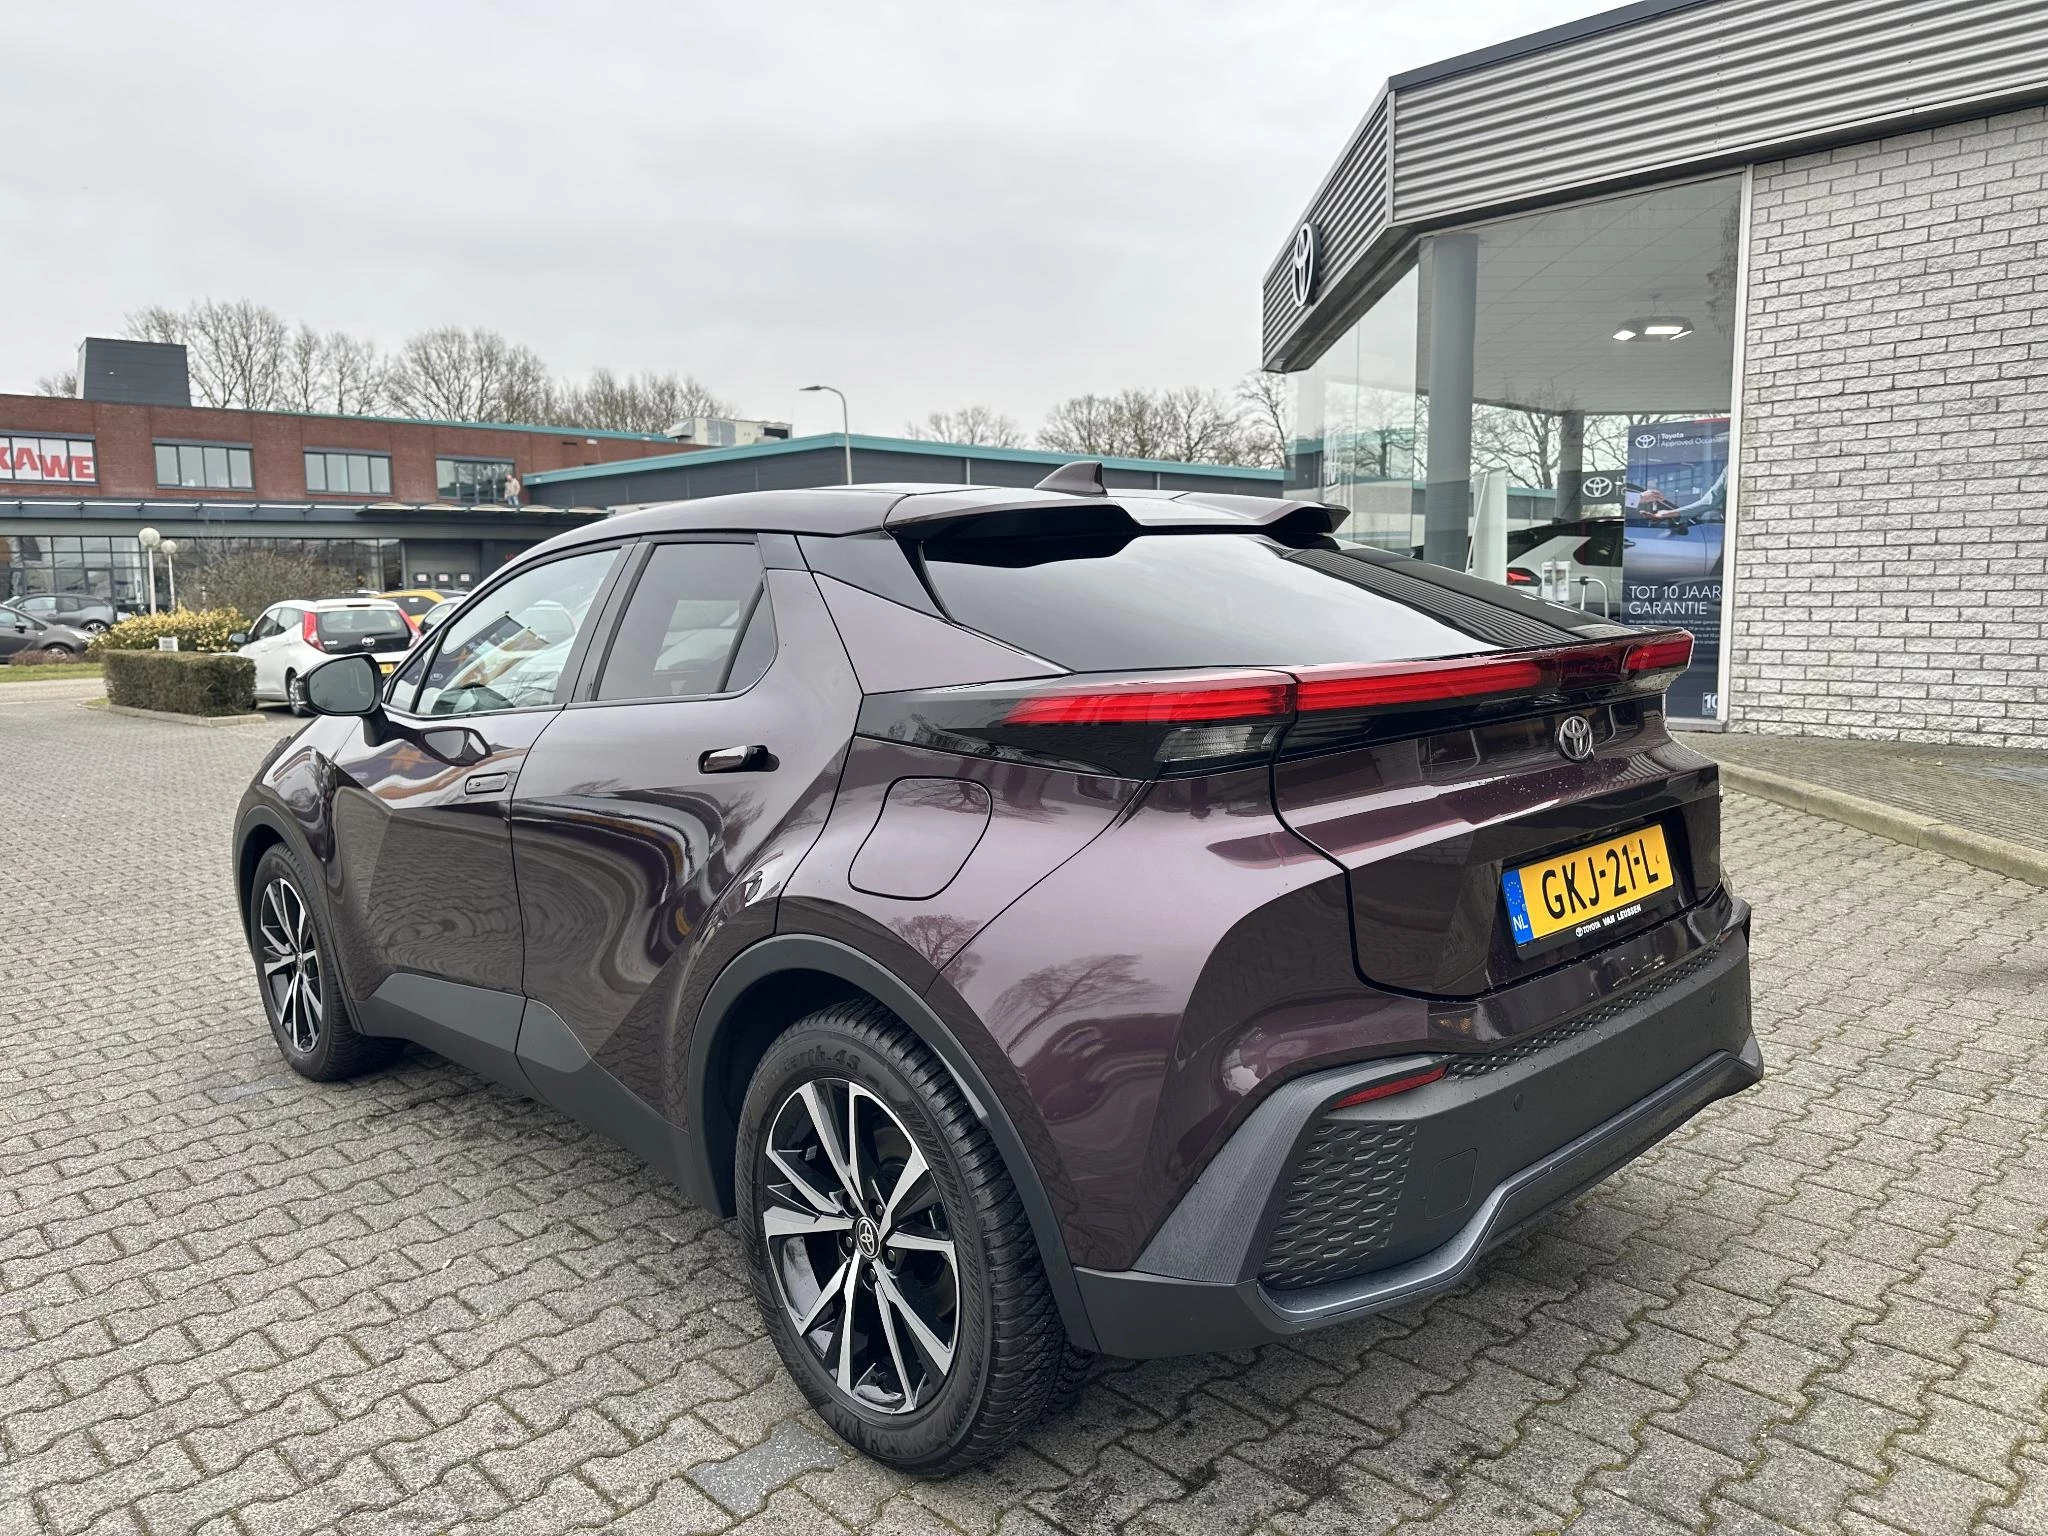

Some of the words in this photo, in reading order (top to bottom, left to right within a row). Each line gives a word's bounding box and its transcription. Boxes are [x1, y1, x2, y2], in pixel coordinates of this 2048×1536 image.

[1661, 432, 1684, 441] Toyota
[1661, 439, 1693, 447] Approved
[1629, 586, 1658, 599] TOT
[1662, 586, 1678, 599] 10
[1682, 585, 1721, 599] JAAR
[1628, 601, 1708, 615] GARANTIE
[1541, 839, 1659, 919] GKJ-21-L
[1512, 914, 1528, 932] NL
[1583, 921, 1601, 934] TOYOTA
[1602, 915, 1616, 926] VAN
